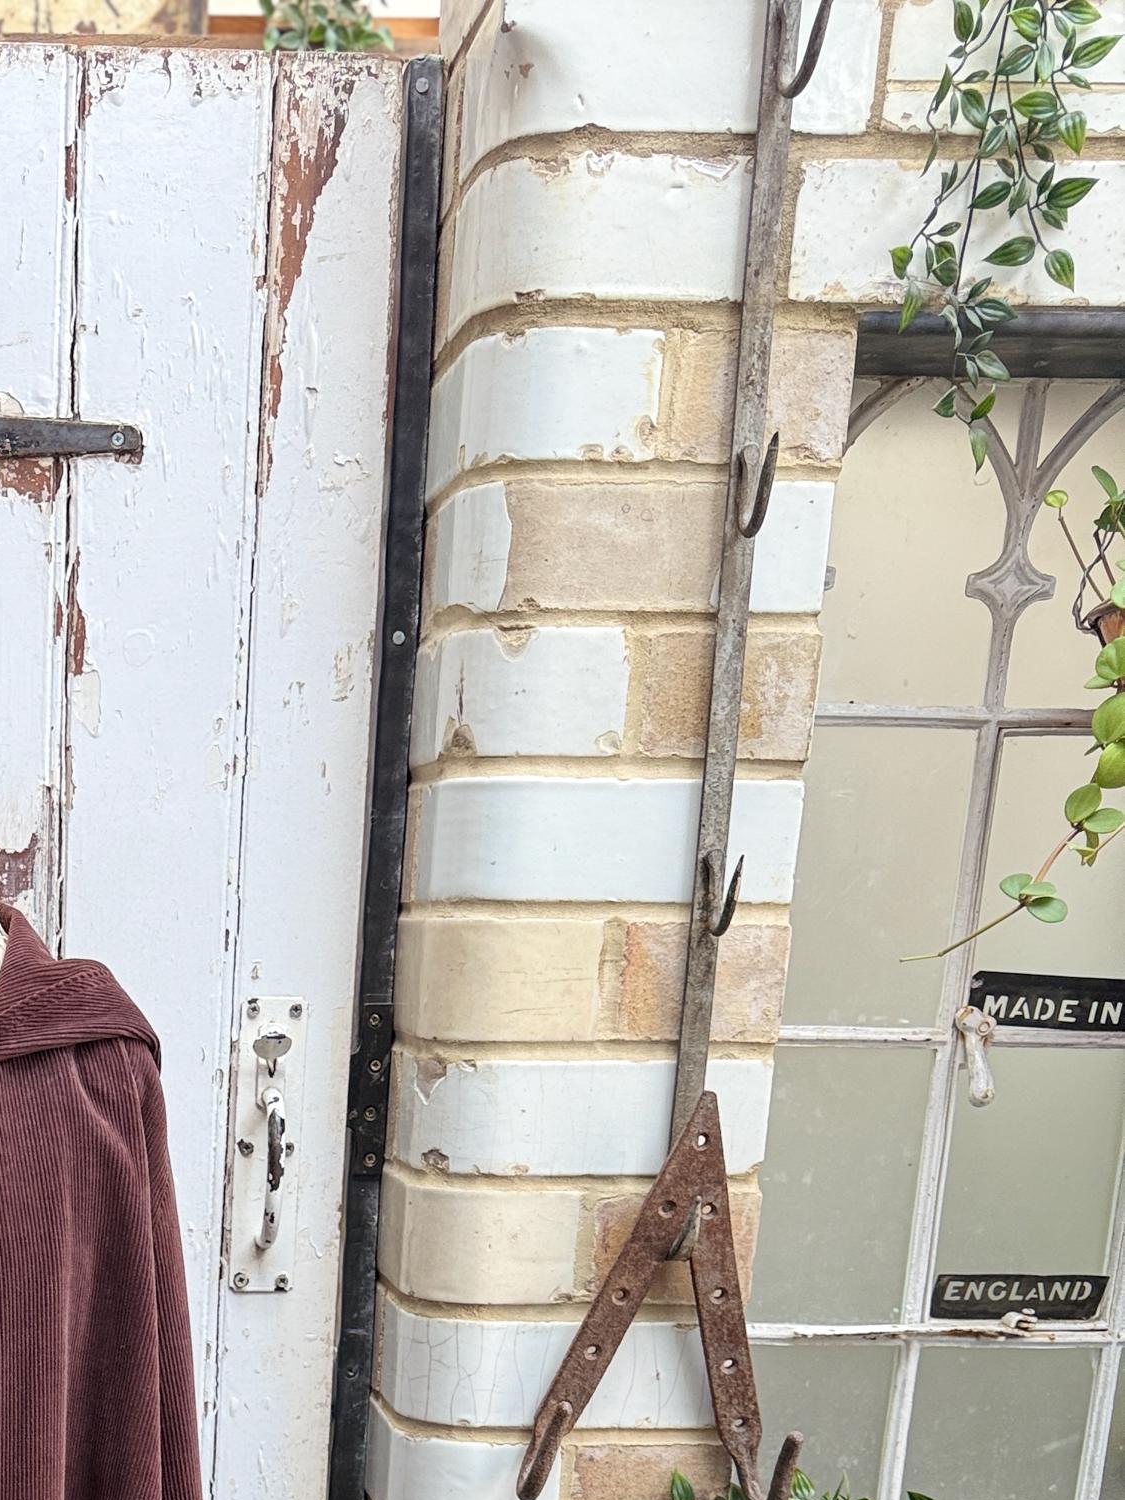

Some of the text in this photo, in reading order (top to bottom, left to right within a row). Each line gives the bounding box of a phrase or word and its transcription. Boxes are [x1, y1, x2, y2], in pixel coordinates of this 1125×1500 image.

[982, 994, 1123, 1025] MADE IN
[943, 1281, 1093, 1301] ENGLAND
